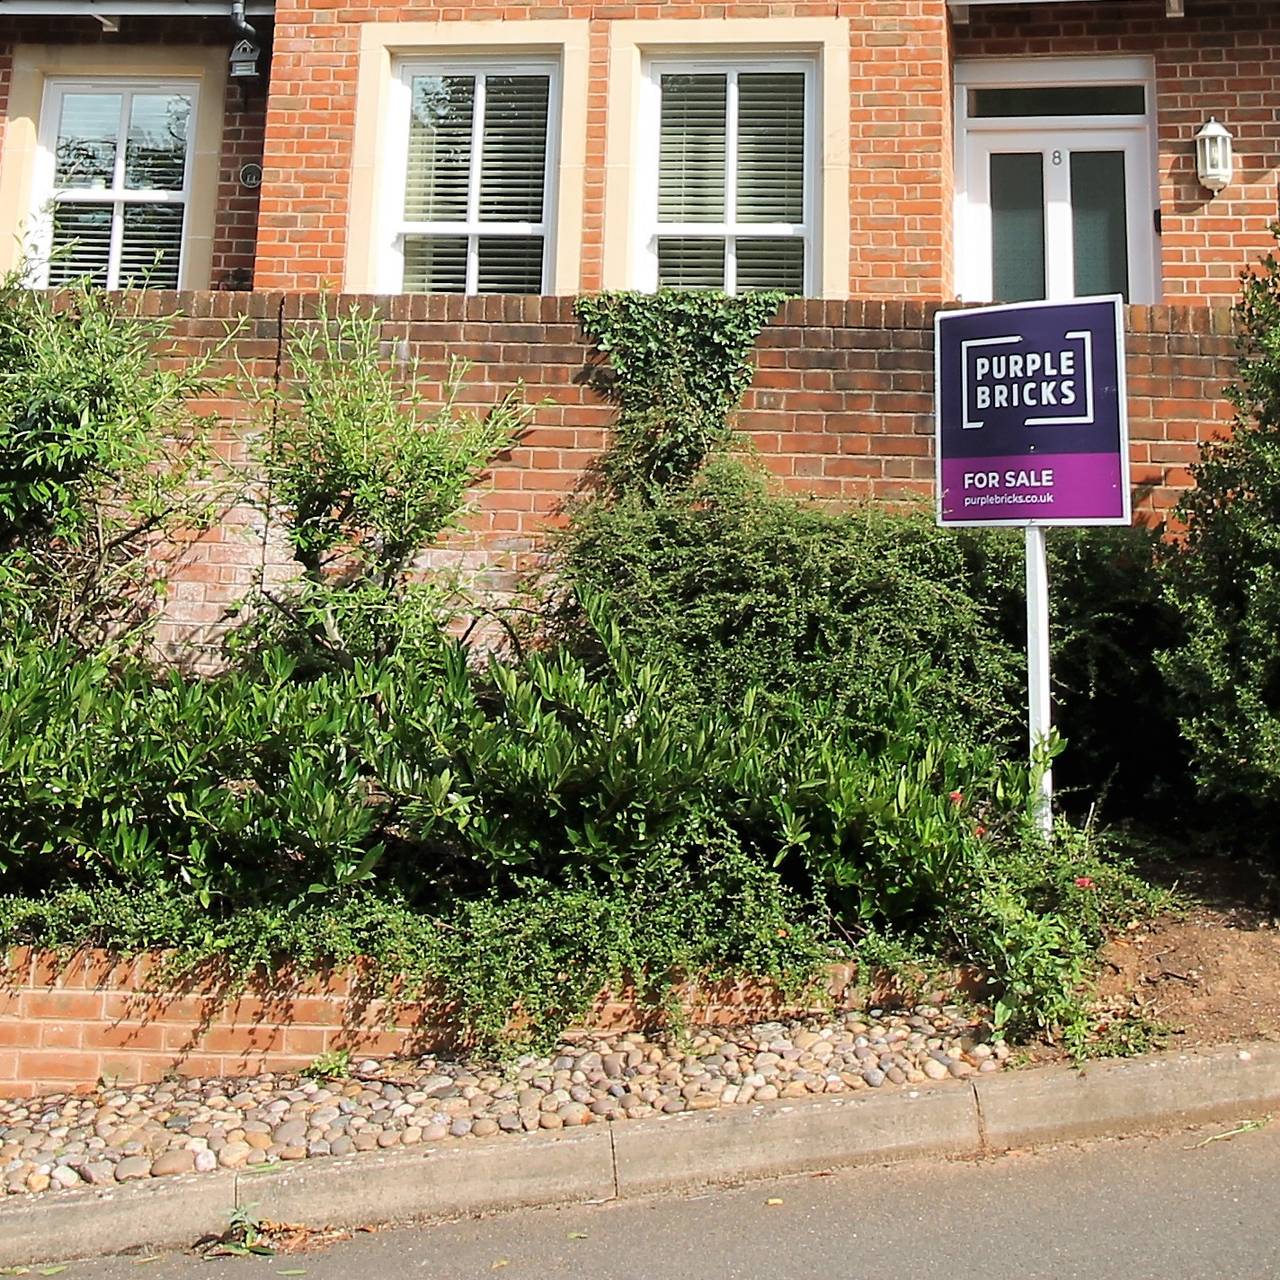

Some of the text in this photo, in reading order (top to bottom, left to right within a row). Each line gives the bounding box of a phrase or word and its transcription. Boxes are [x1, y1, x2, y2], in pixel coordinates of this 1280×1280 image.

[1052, 150, 1062, 166] 8
[976, 351, 1074, 380] PURPLE
[976, 380, 1076, 409] BRICKS
[964, 470, 1054, 489] FOR SALE
[964, 492, 1054, 507] purplebricks.co.uk
